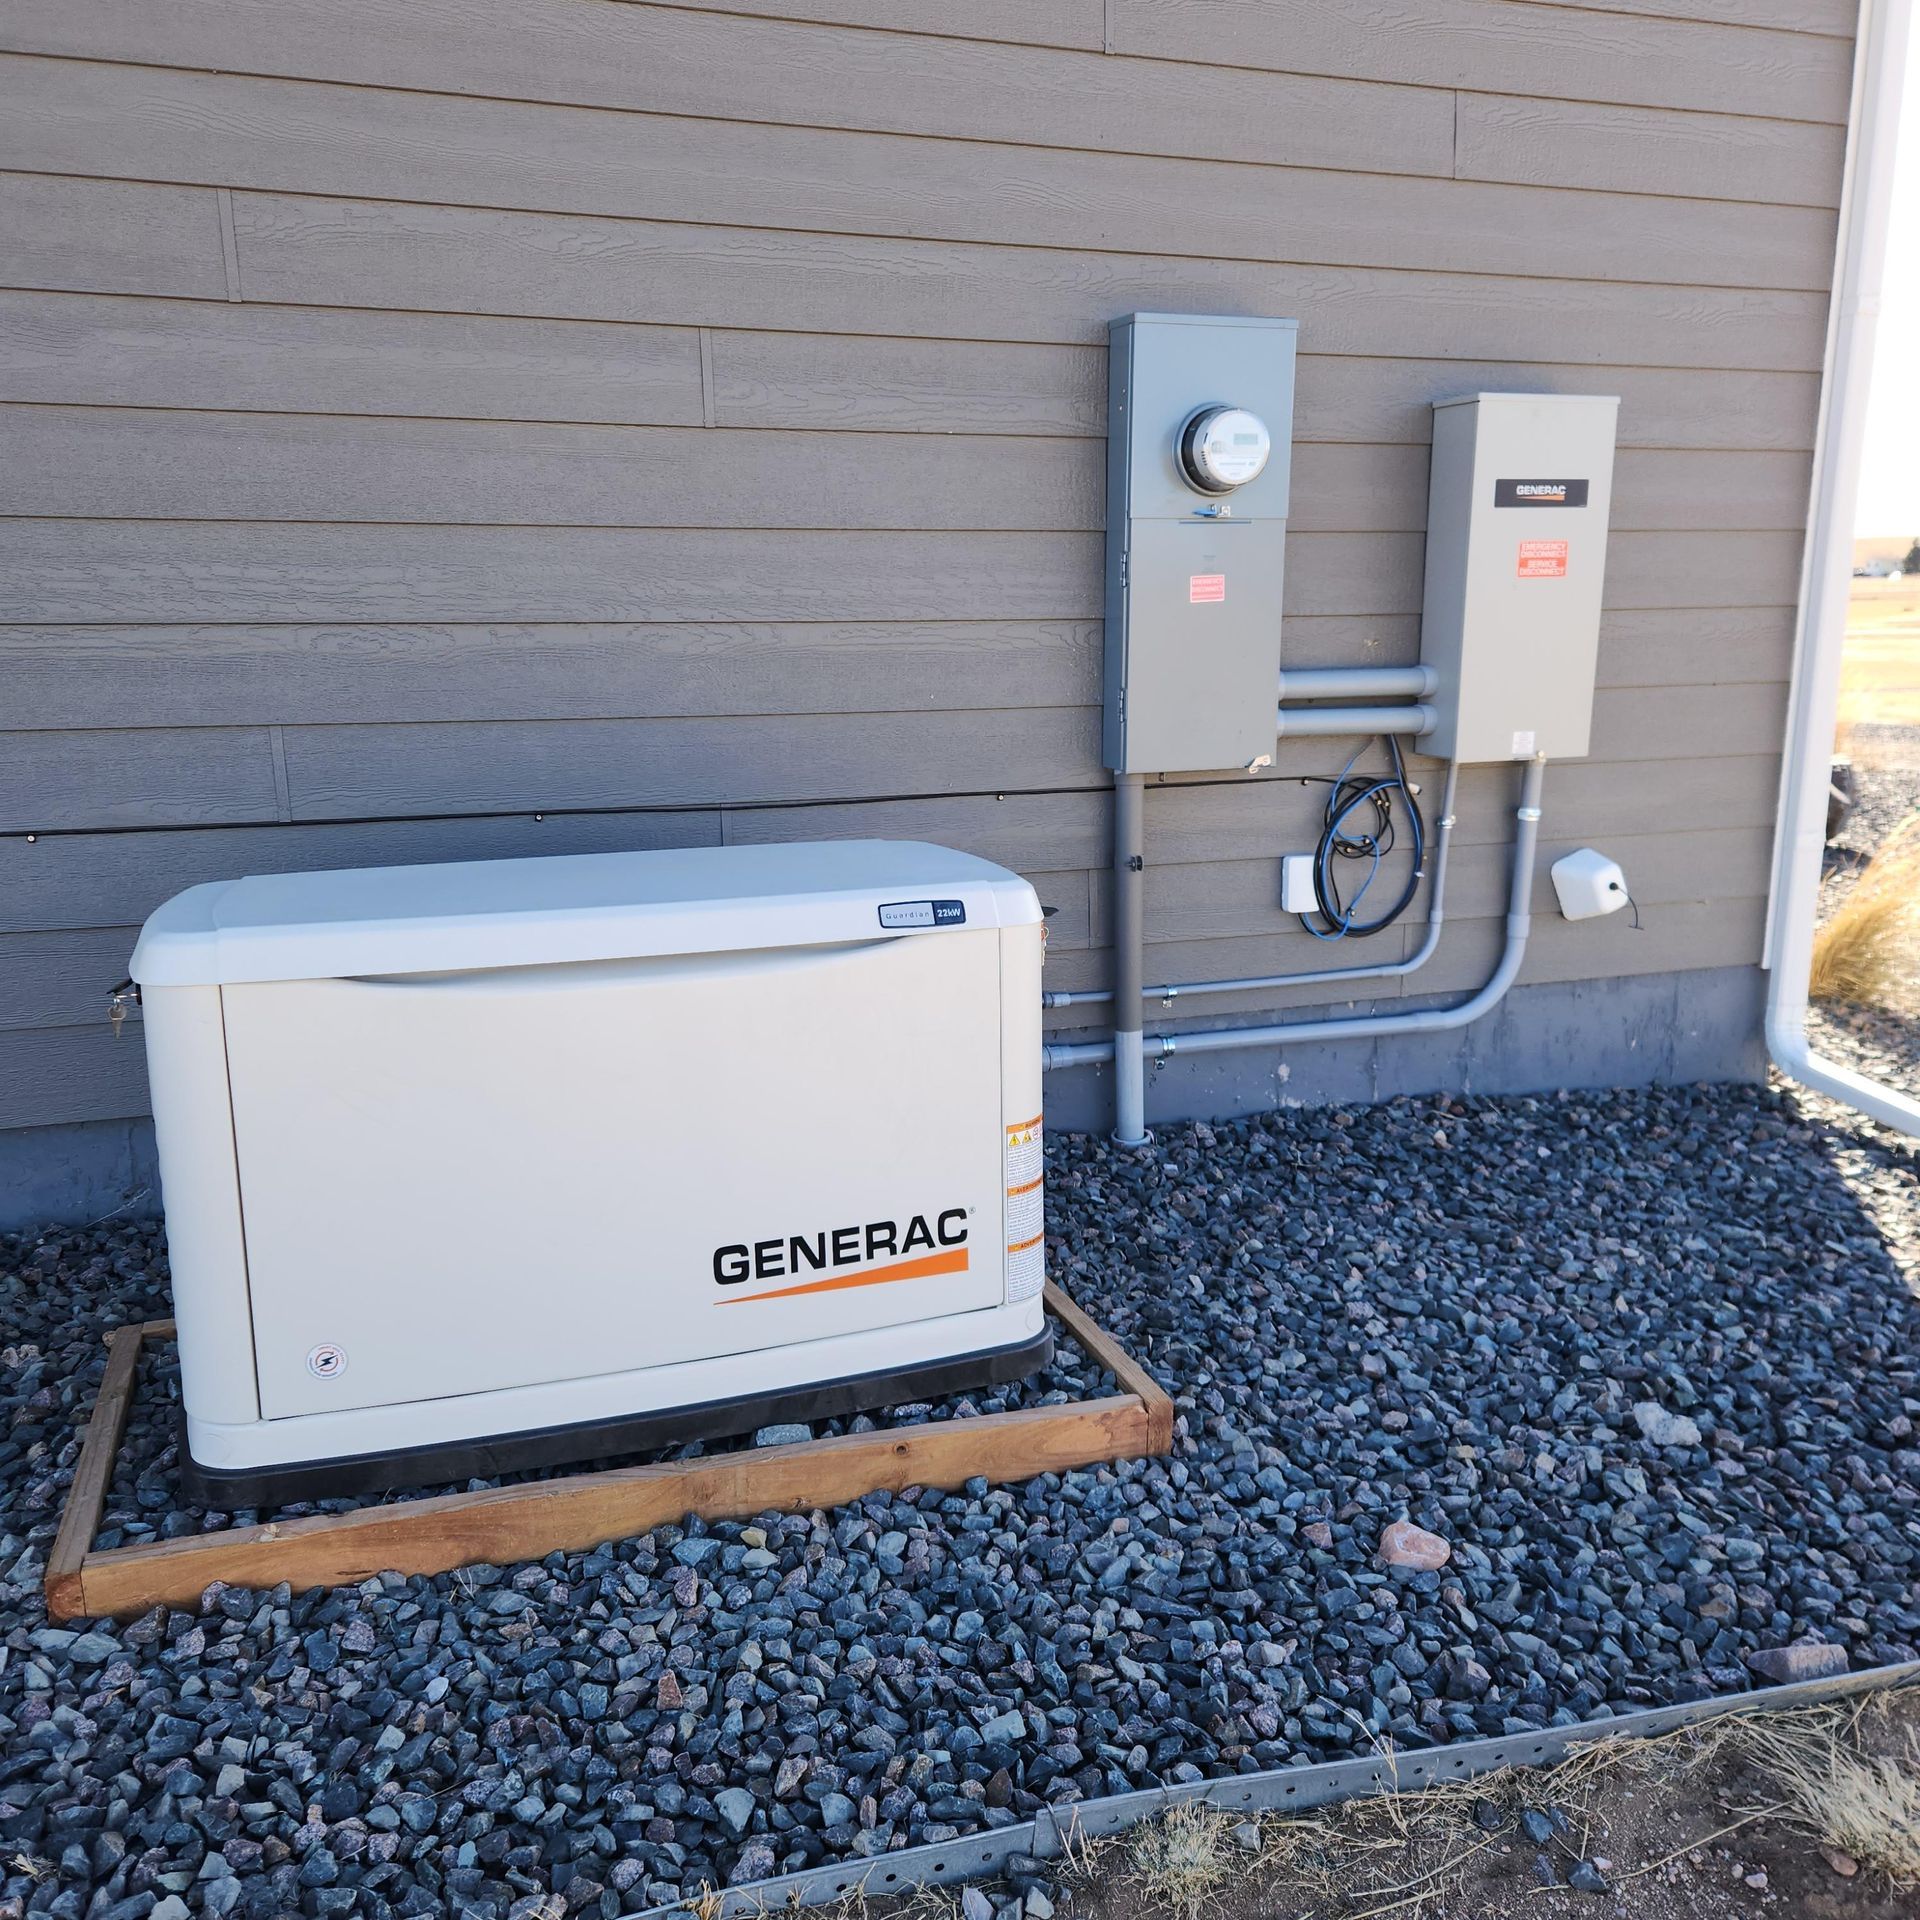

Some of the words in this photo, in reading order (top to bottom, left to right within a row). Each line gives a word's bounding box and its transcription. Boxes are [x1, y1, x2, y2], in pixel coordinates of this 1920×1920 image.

[1516, 485, 1566, 495] GENERAC
[1520, 550, 1566, 558] DISCONNECT
[1527, 559, 1559, 567] SERVICE
[1519, 567, 1565, 575] DISCONNECT
[886, 911, 930, 919] Guardian
[937, 908, 961, 917] 22kW
[713, 1208, 968, 1285] GENERAC
